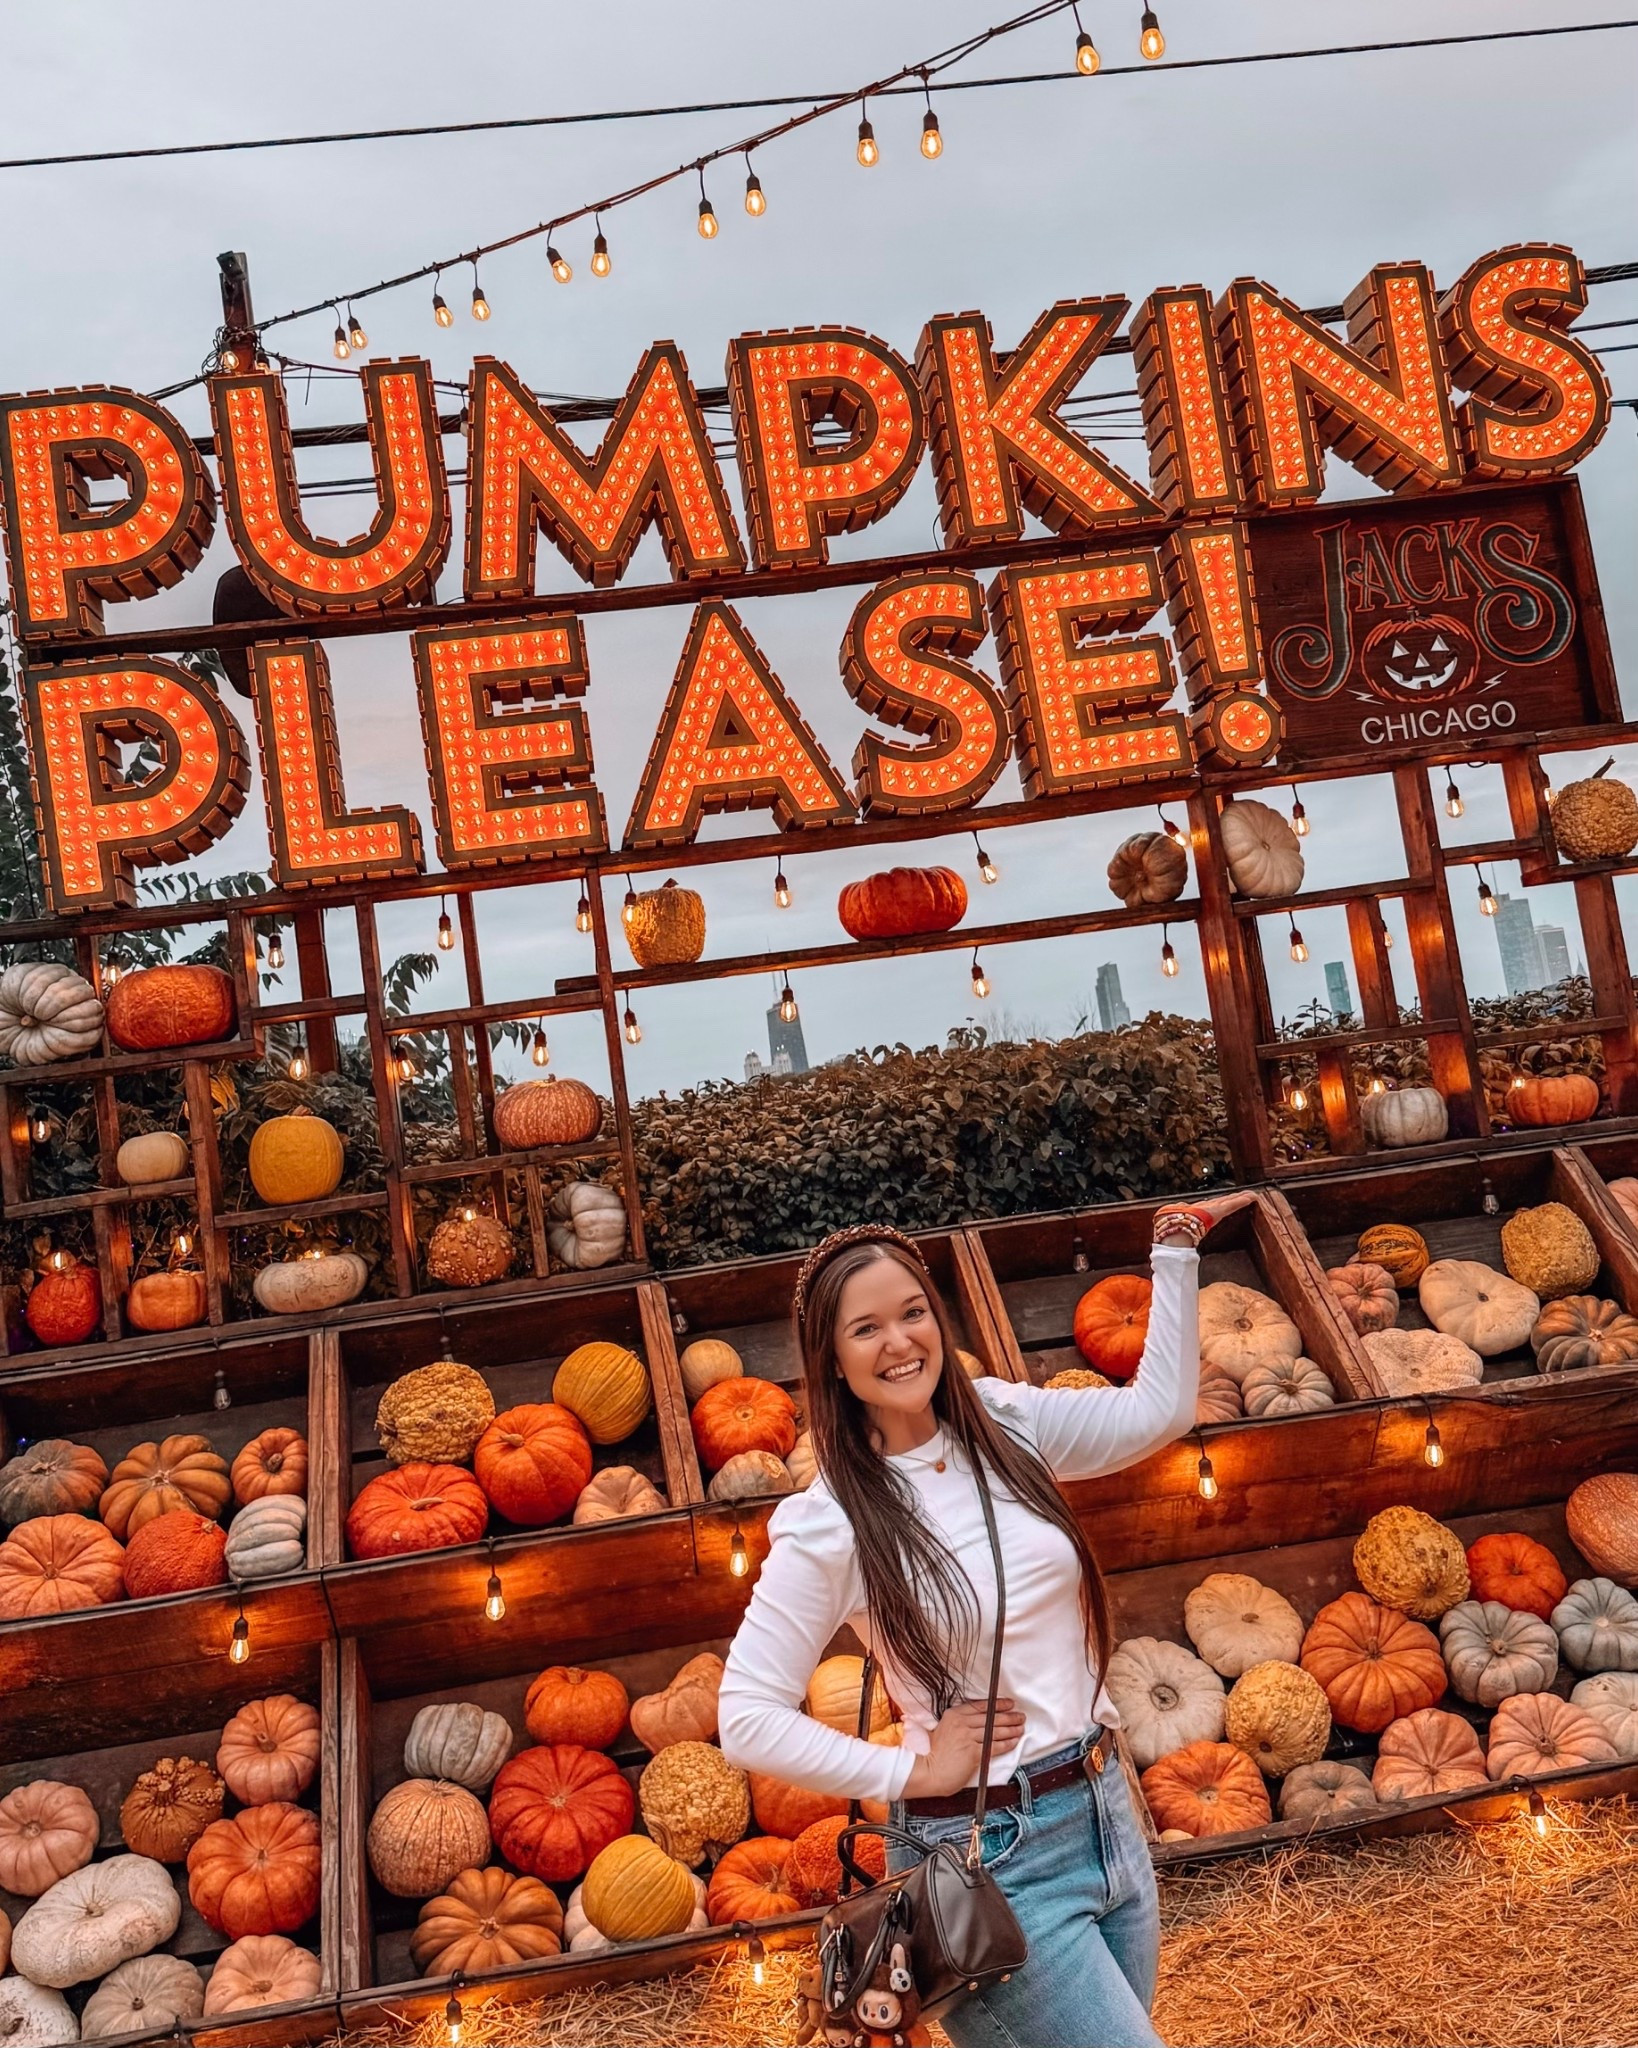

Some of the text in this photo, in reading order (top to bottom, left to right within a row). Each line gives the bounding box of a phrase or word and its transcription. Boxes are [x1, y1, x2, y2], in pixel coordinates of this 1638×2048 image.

[2, 246, 1608, 636] PUMPKINS
[27, 524, 1282, 908] PLEASE!
[1271, 518, 1576, 701] JACKS
[1361, 700, 1516, 744] CHICAGO
